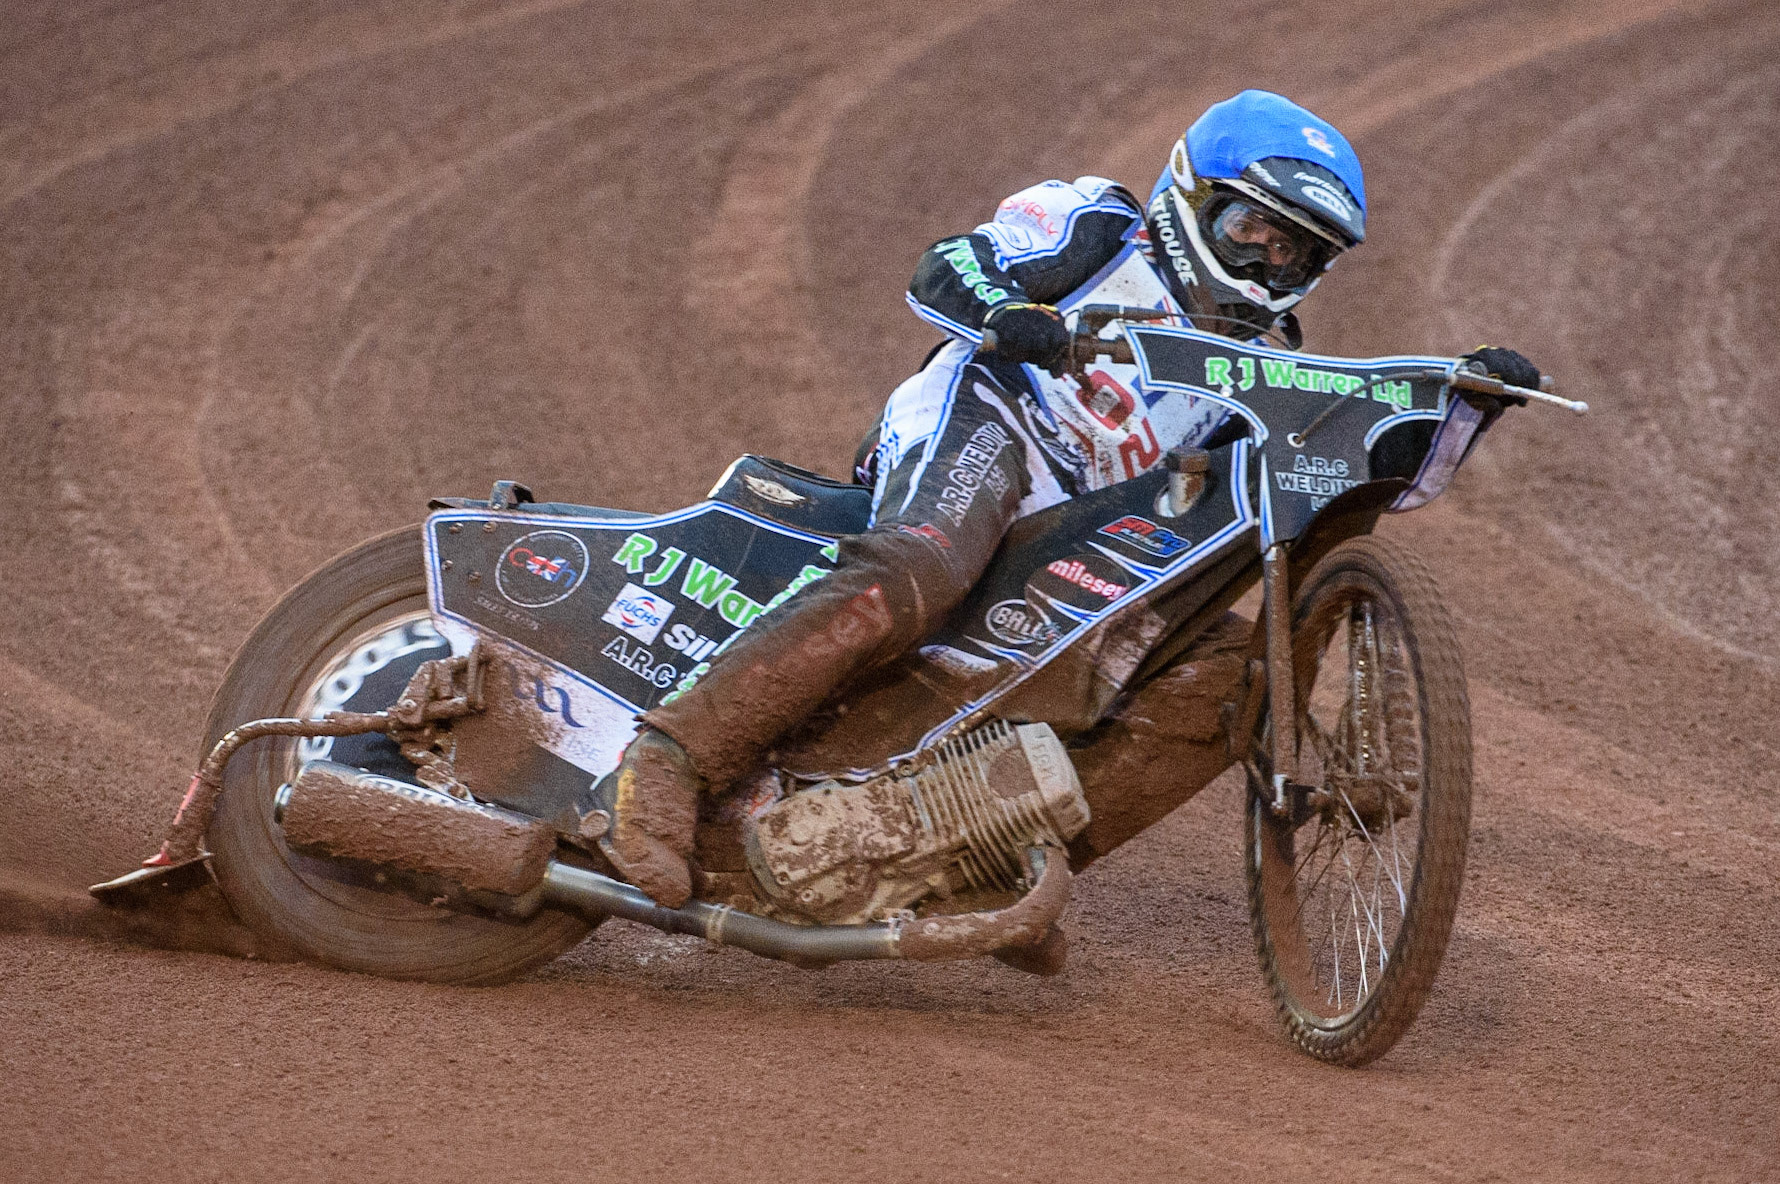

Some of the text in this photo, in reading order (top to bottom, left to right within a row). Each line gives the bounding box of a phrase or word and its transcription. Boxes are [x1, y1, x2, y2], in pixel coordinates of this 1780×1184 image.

[1260, 359, 1367, 398] Warren
[1370, 374, 1412, 409] Ltd
[680, 557, 767, 628] War
[1047, 559, 1127, 601] milesey
[615, 598, 661, 628] FUCHS
[663, 623, 719, 662] Sil
